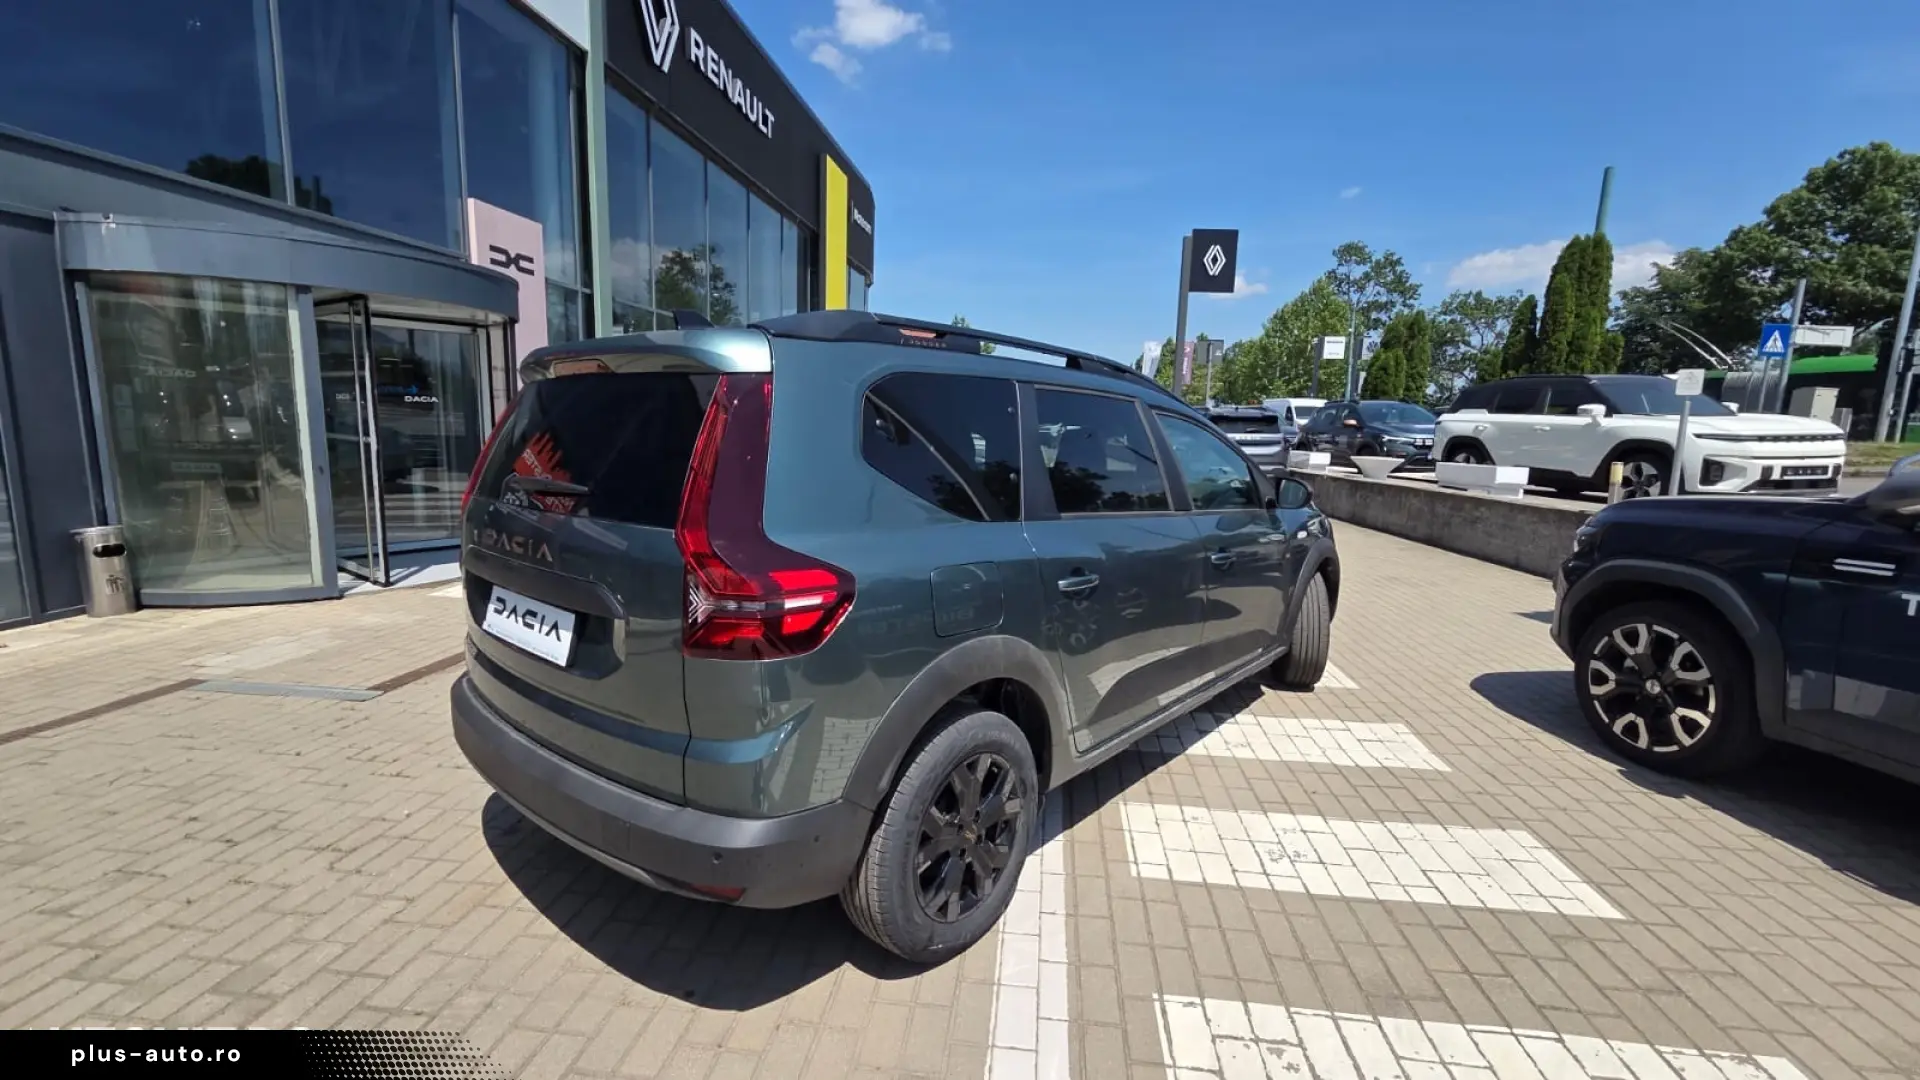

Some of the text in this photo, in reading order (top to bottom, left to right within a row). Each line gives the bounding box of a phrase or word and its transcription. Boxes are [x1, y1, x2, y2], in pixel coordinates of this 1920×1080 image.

[690, 26, 775, 139] RENAULT
[404, 395, 439, 403] DACIA
[481, 528, 553, 562] DACIA
[492, 595, 562, 643] DACIA
